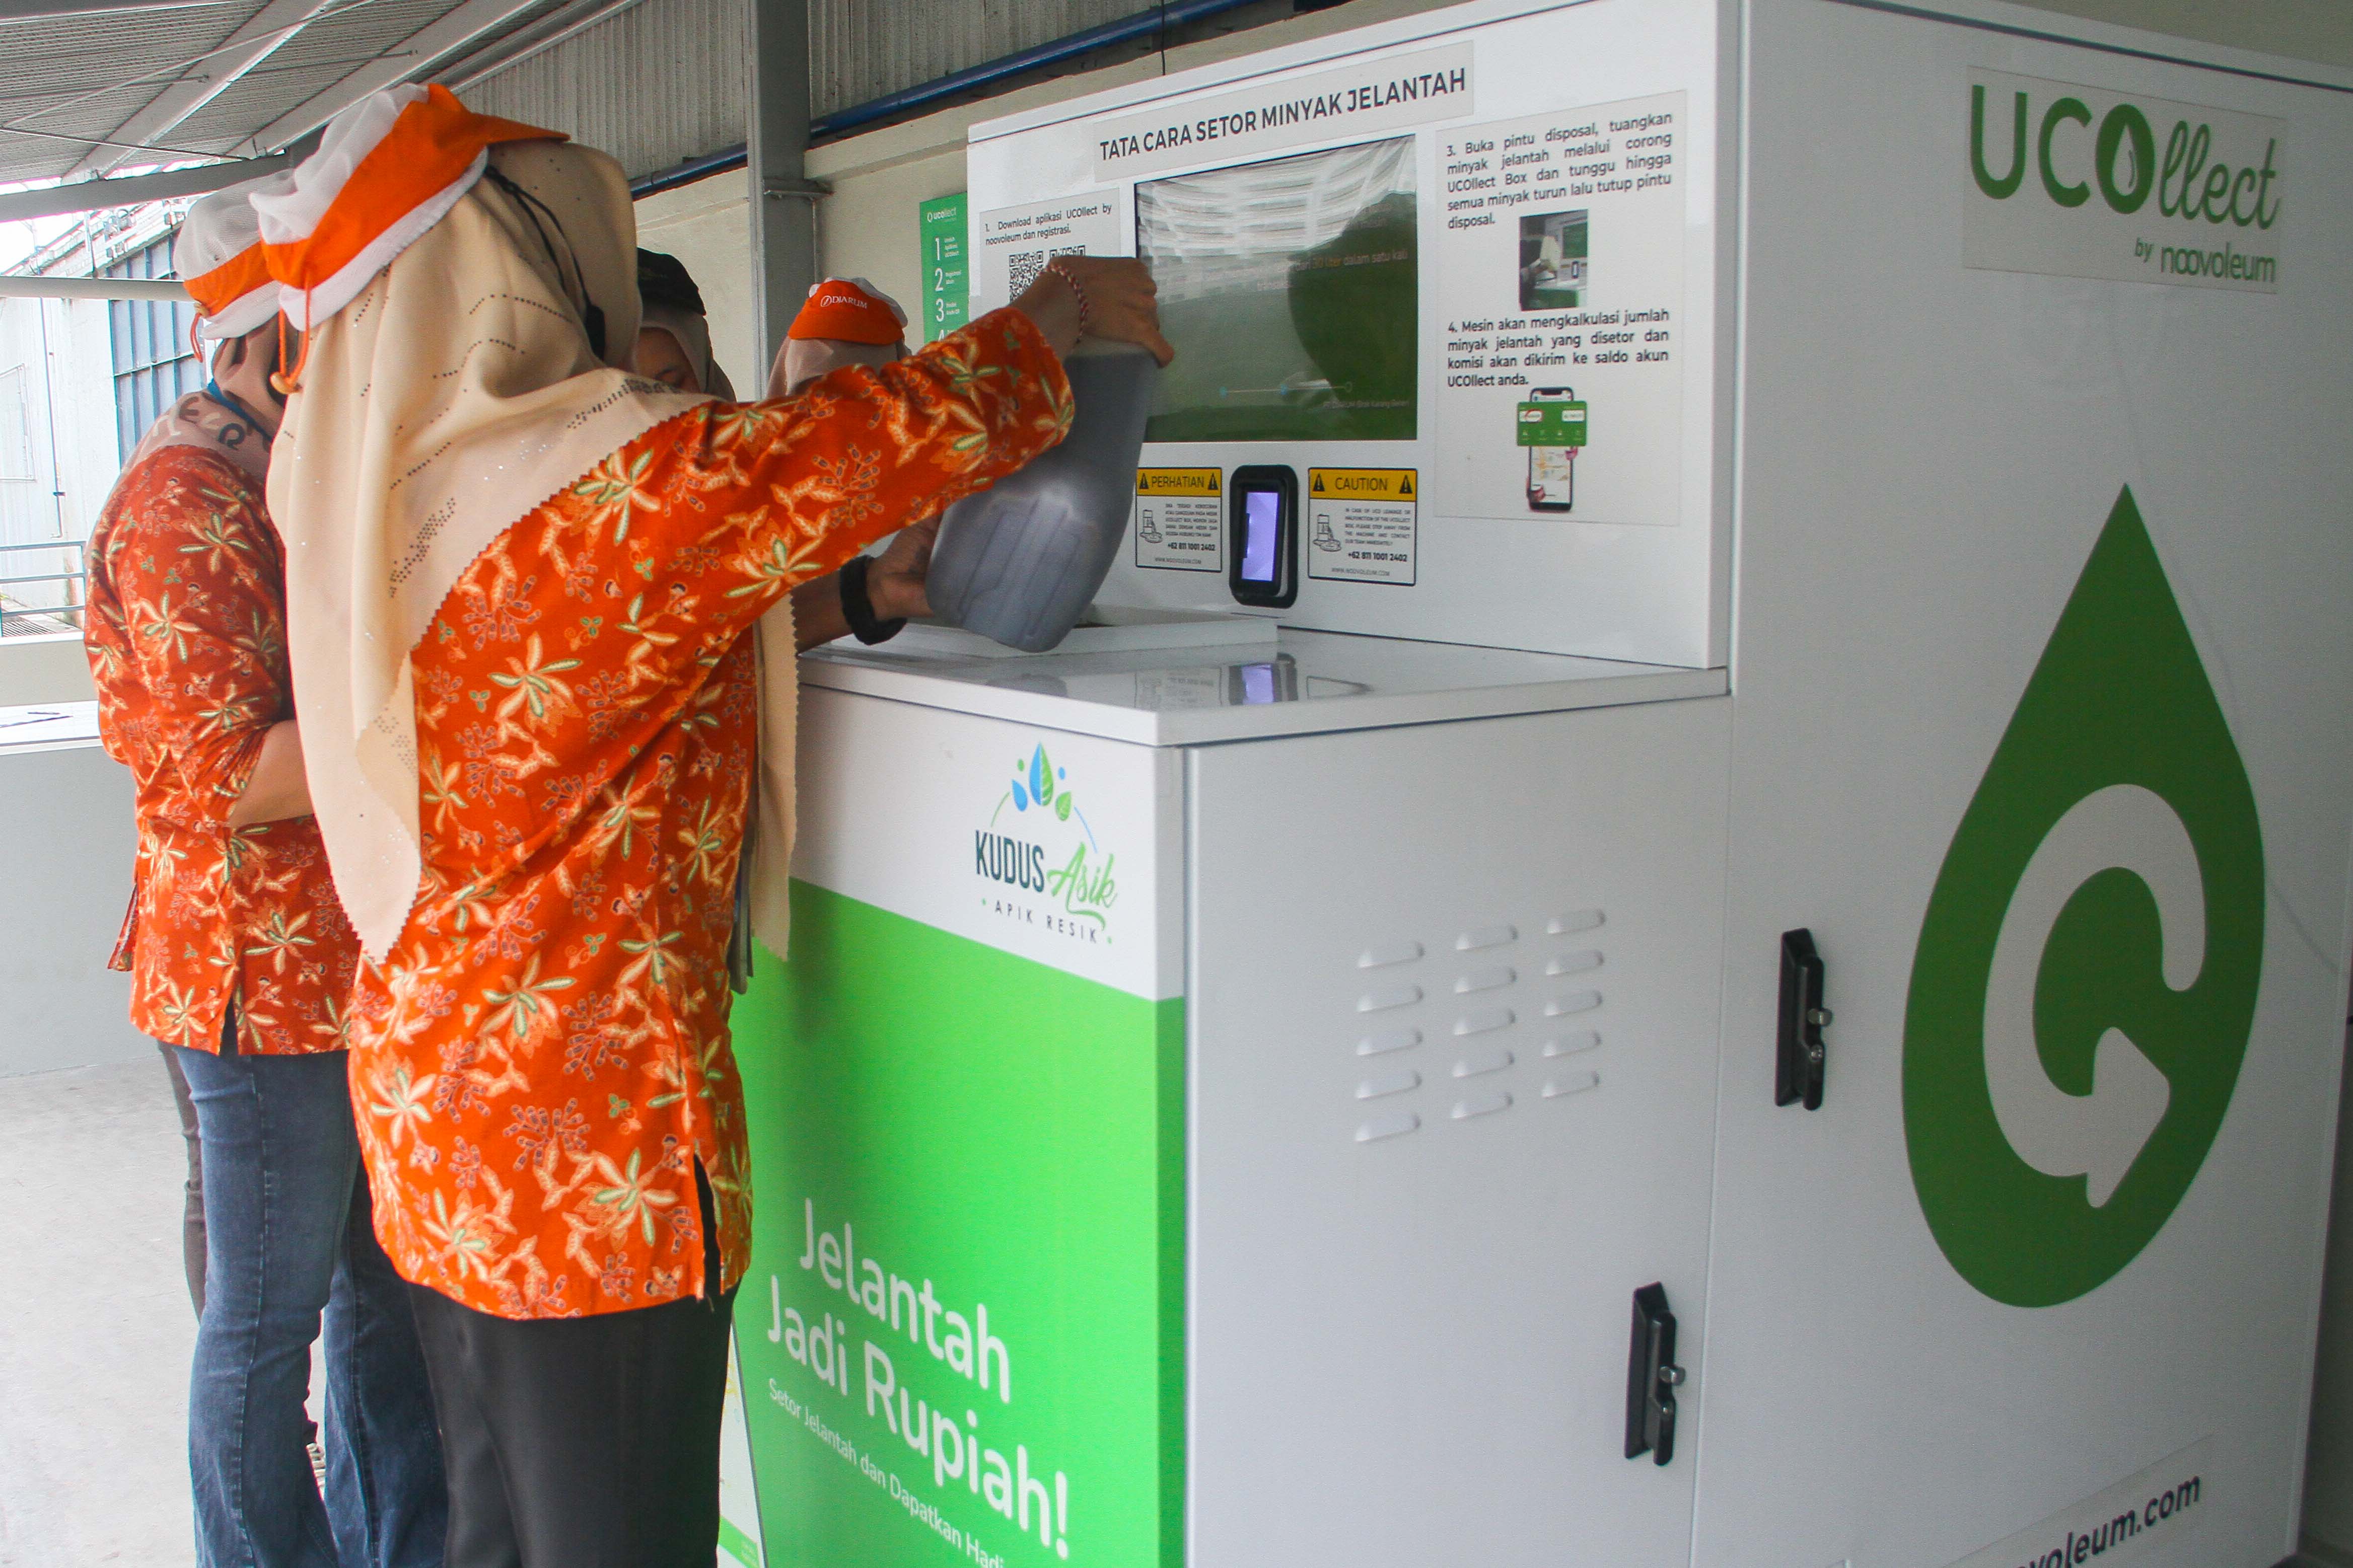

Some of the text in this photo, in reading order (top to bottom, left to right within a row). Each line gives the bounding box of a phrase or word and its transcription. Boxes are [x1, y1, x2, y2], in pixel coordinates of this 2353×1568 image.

[1100, 67, 1466, 160] TATA CARA SETOR MINYAK JELANTAH
[1447, 113, 1672, 157] 3. Buka pintu disposal, tuangkan
[1448, 134, 1672, 177] minyak jelantah melalui corong
[1505, 173, 1527, 185] Box
[1536, 169, 1559, 181] dan
[1569, 161, 1615, 178] tunggu
[1626, 154, 1672, 171] hingga
[1970, 84, 2280, 230] UCOllect
[1448, 173, 1672, 211] semua minyak turun lalu tutup pintu
[998, 216, 1031, 230] Download
[1036, 211, 1062, 225] aplikasi
[1103, 203, 1112, 214] by
[1448, 213, 1495, 230] disposal.
[935, 237, 941, 261] 1
[986, 224, 1071, 245] noovoleum dan registrasi.
[2135, 238, 2276, 283] by noovoleum
[935, 268, 944, 292] 2
[936, 298, 945, 322] 3
[1448, 309, 1669, 333] 4. Mesin akan mengkalkulasi jumlah
[1448, 330, 1669, 352] minyak jelantah yang disetor dan
[1448, 350, 1669, 369] komisi akan dikirim ke saldo akun
[1498, 373, 1529, 386] anda.
[1152, 476, 1204, 488] PERHATIAN
[1335, 477, 1388, 491] CAUTION
[975, 830, 1117, 931] KUDUS Asik
[995, 900, 1097, 943] APIK RESIK
[800, 1197, 1010, 1404] Jelantah
[768, 1275, 1069, 1559] Jadi Rupiah!
[769, 1378, 801, 1418] Setor
[804, 1405, 857, 1465] Jelantah
[860, 1453, 886, 1489] dan
[889, 1472, 962, 1550] Dapatkan
